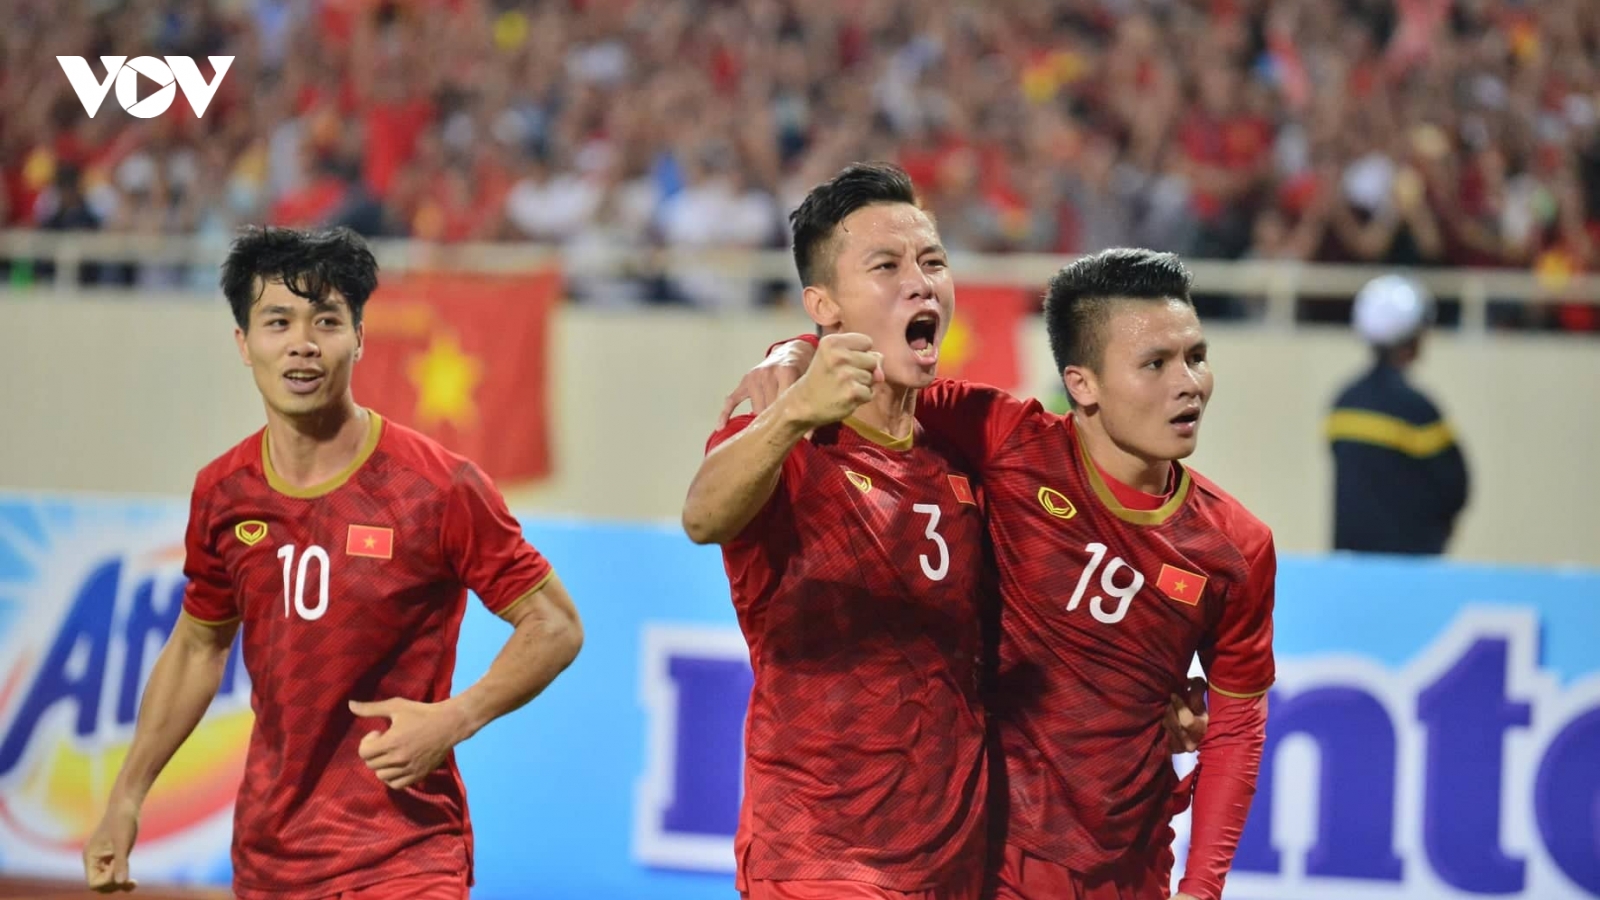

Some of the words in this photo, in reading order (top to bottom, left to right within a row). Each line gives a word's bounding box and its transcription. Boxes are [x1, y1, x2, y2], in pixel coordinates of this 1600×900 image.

[276, 543, 332, 621] 10
[912, 503, 951, 582] 3
[1066, 542, 1146, 625] 19
